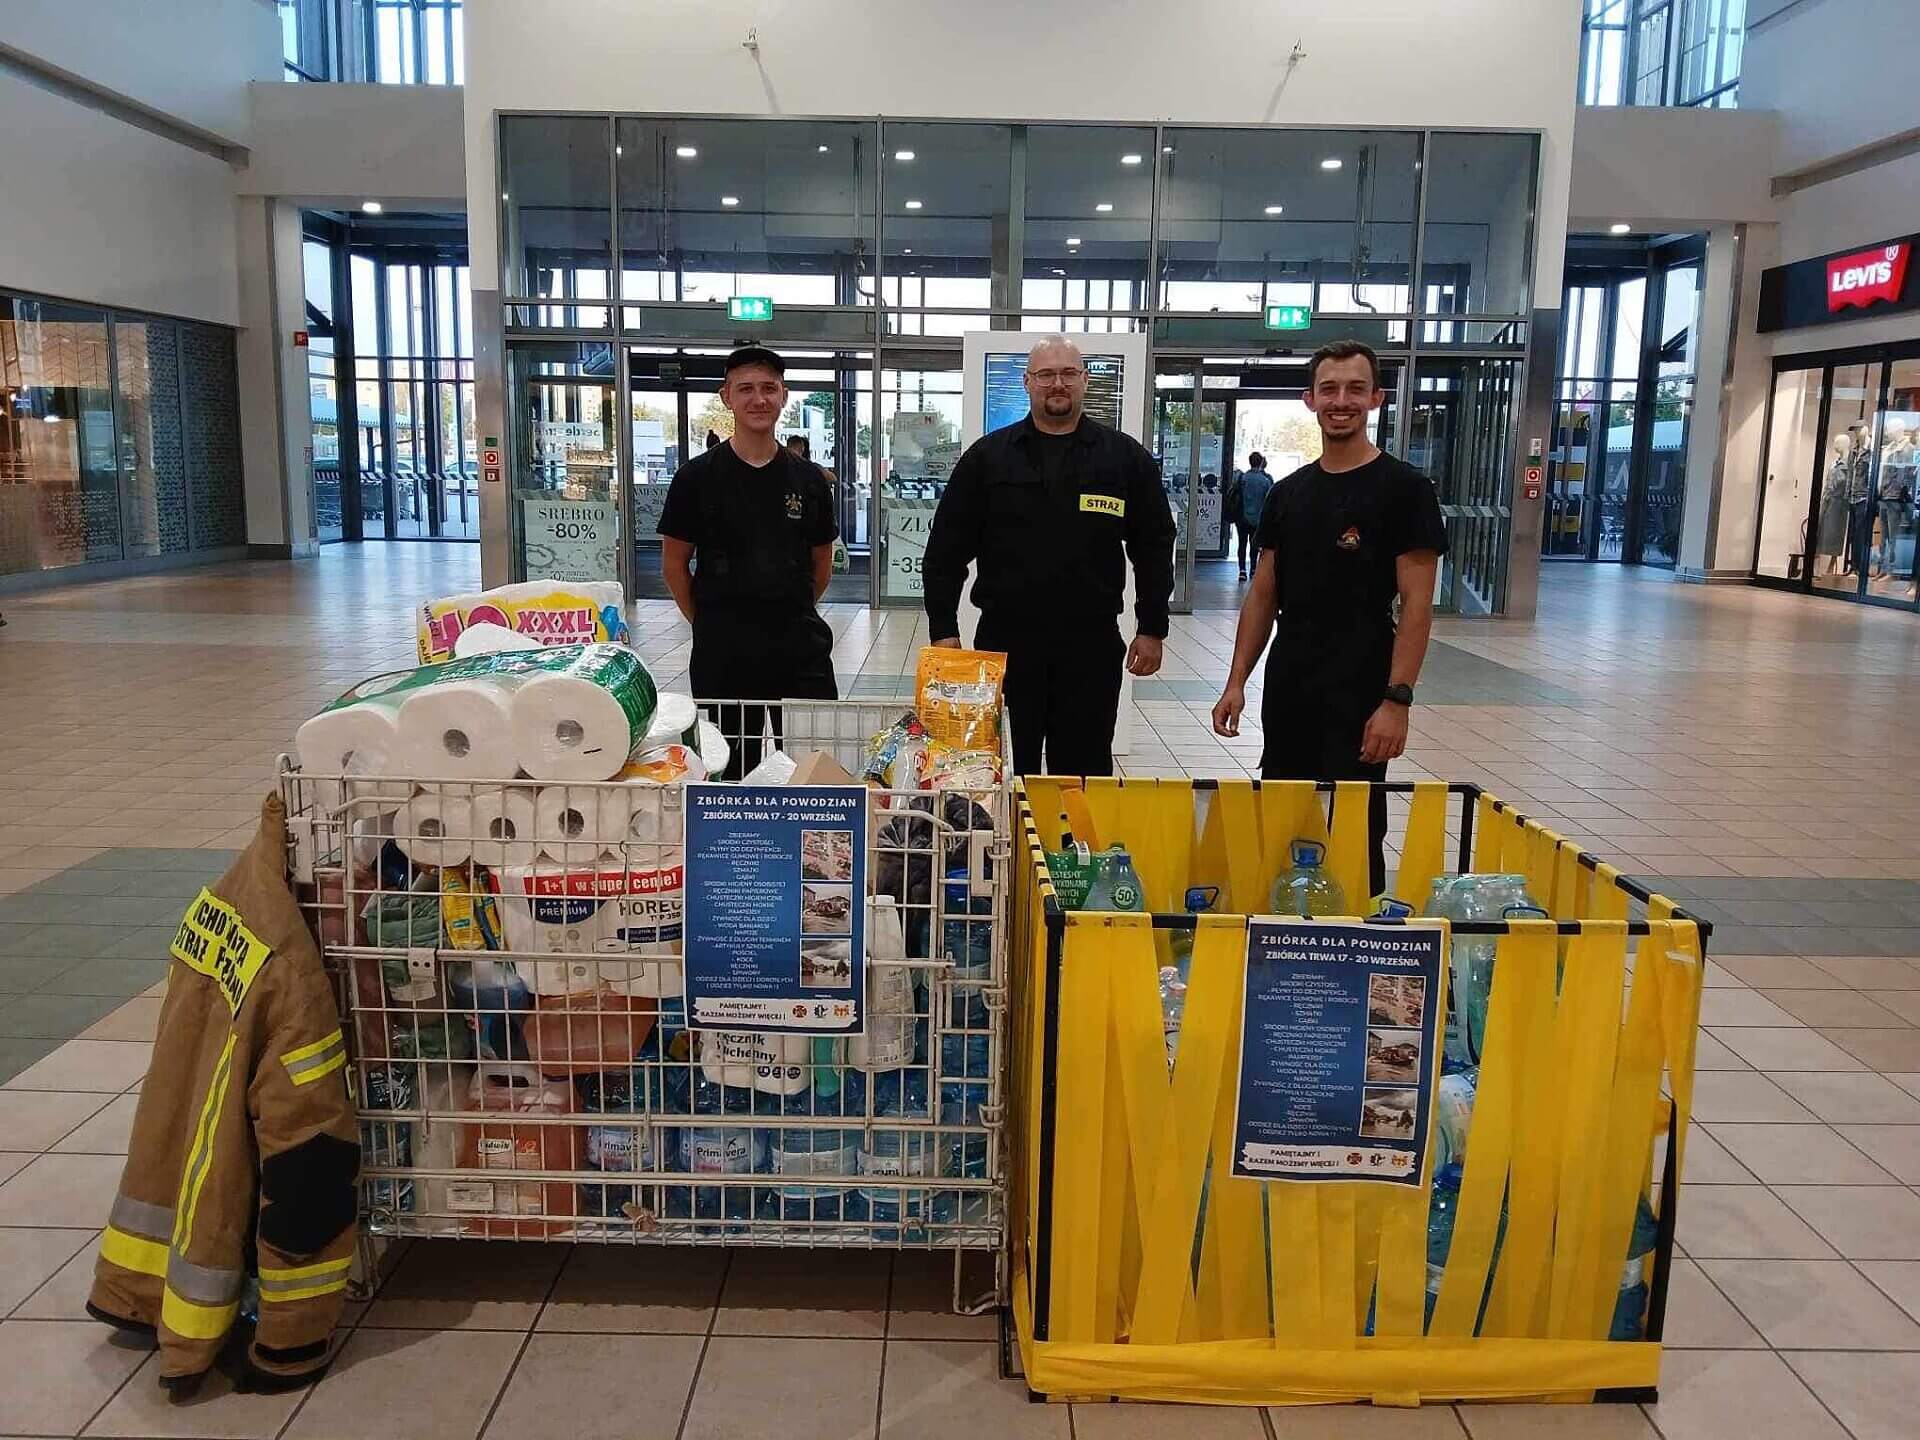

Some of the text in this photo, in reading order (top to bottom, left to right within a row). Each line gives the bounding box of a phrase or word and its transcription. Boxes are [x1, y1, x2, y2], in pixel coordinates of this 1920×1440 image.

[538, 507, 604, 520] SREBRO
[547, 523, 596, 540] -80%
[517, 608, 593, 634] XXXL
[697, 794, 857, 808] ZBIÓRKA DLA POWODZIAN
[703, 810, 742, 820] ZBIÓRKA
[743, 812, 769, 820] TRWA
[787, 812, 799, 821] 20
[801, 811, 846, 822] WRZEŚNIA
[575, 881, 587, 891] w
[1118, 888, 1132, 902] 50
[1261, 934, 1432, 952] ZBIÓRKA DLA POWODZIAN
[1265, 950, 1306, 961] ZBIÓRKA
[1308, 952, 1336, 962] TRWA
[1356, 956, 1368, 964] 20
[1371, 956, 1420, 968] WRZEŚNIA
